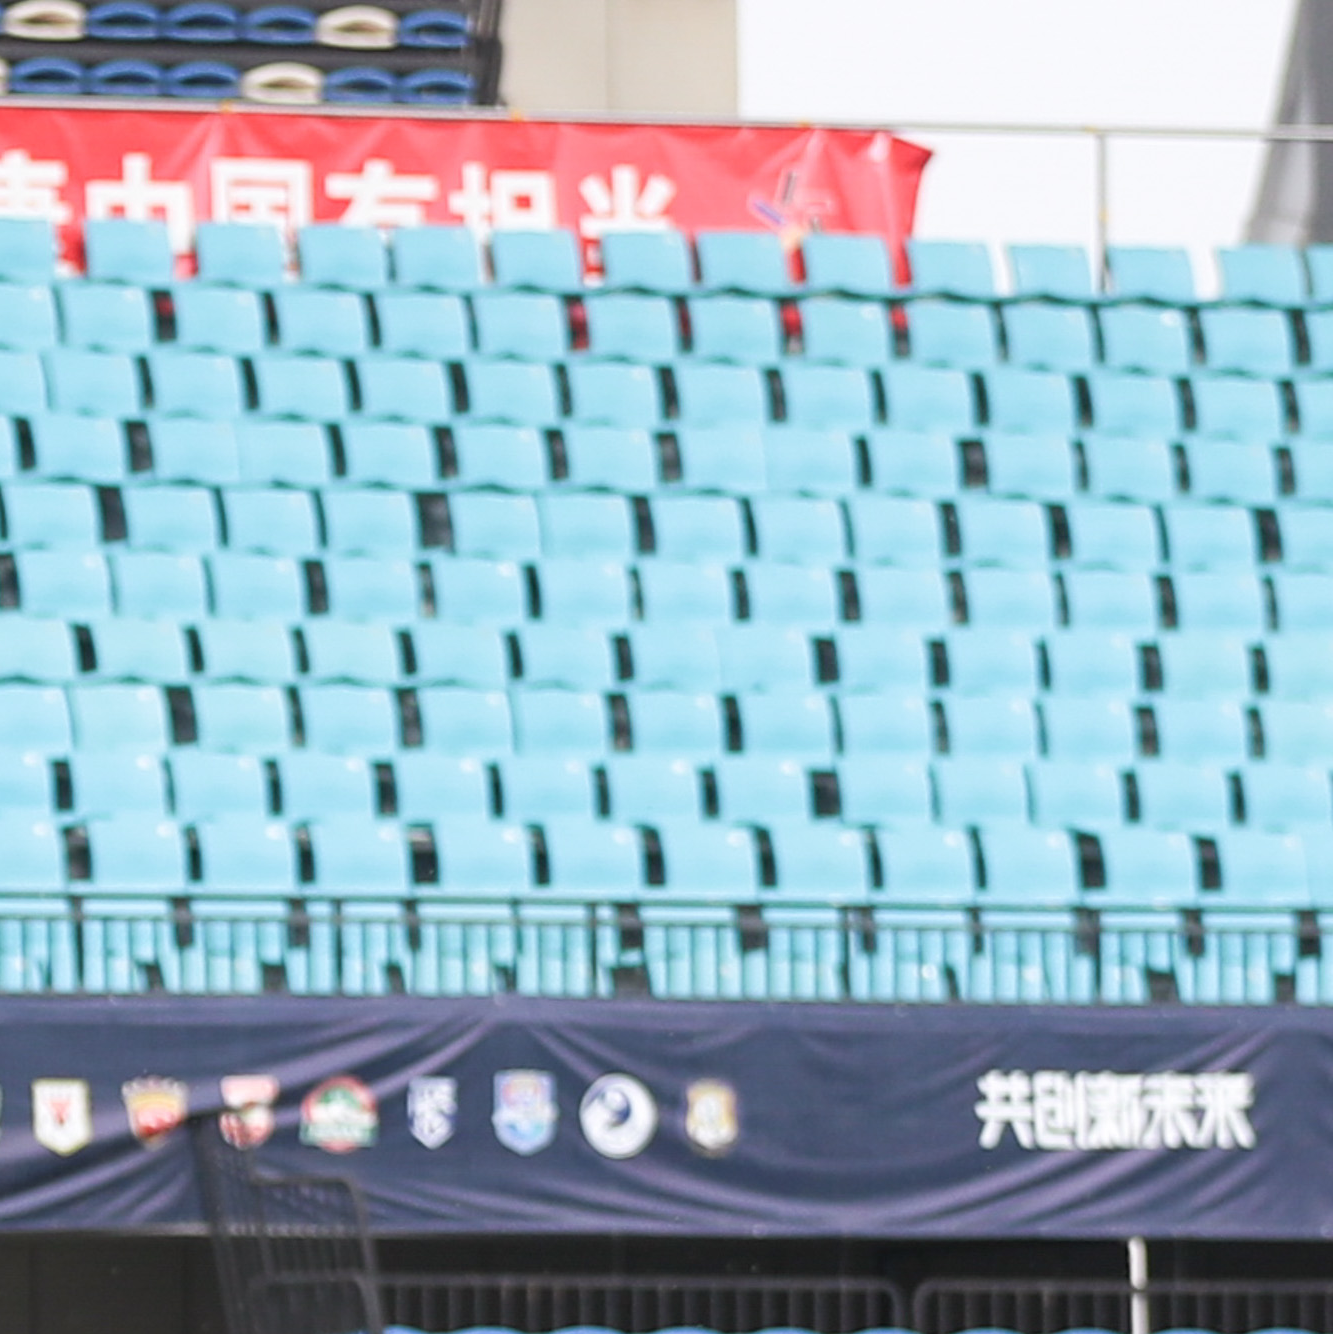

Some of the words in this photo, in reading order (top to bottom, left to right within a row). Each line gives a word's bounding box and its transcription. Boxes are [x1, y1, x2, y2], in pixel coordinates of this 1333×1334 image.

[975, 1070, 1257, 1150] 共创新未来
